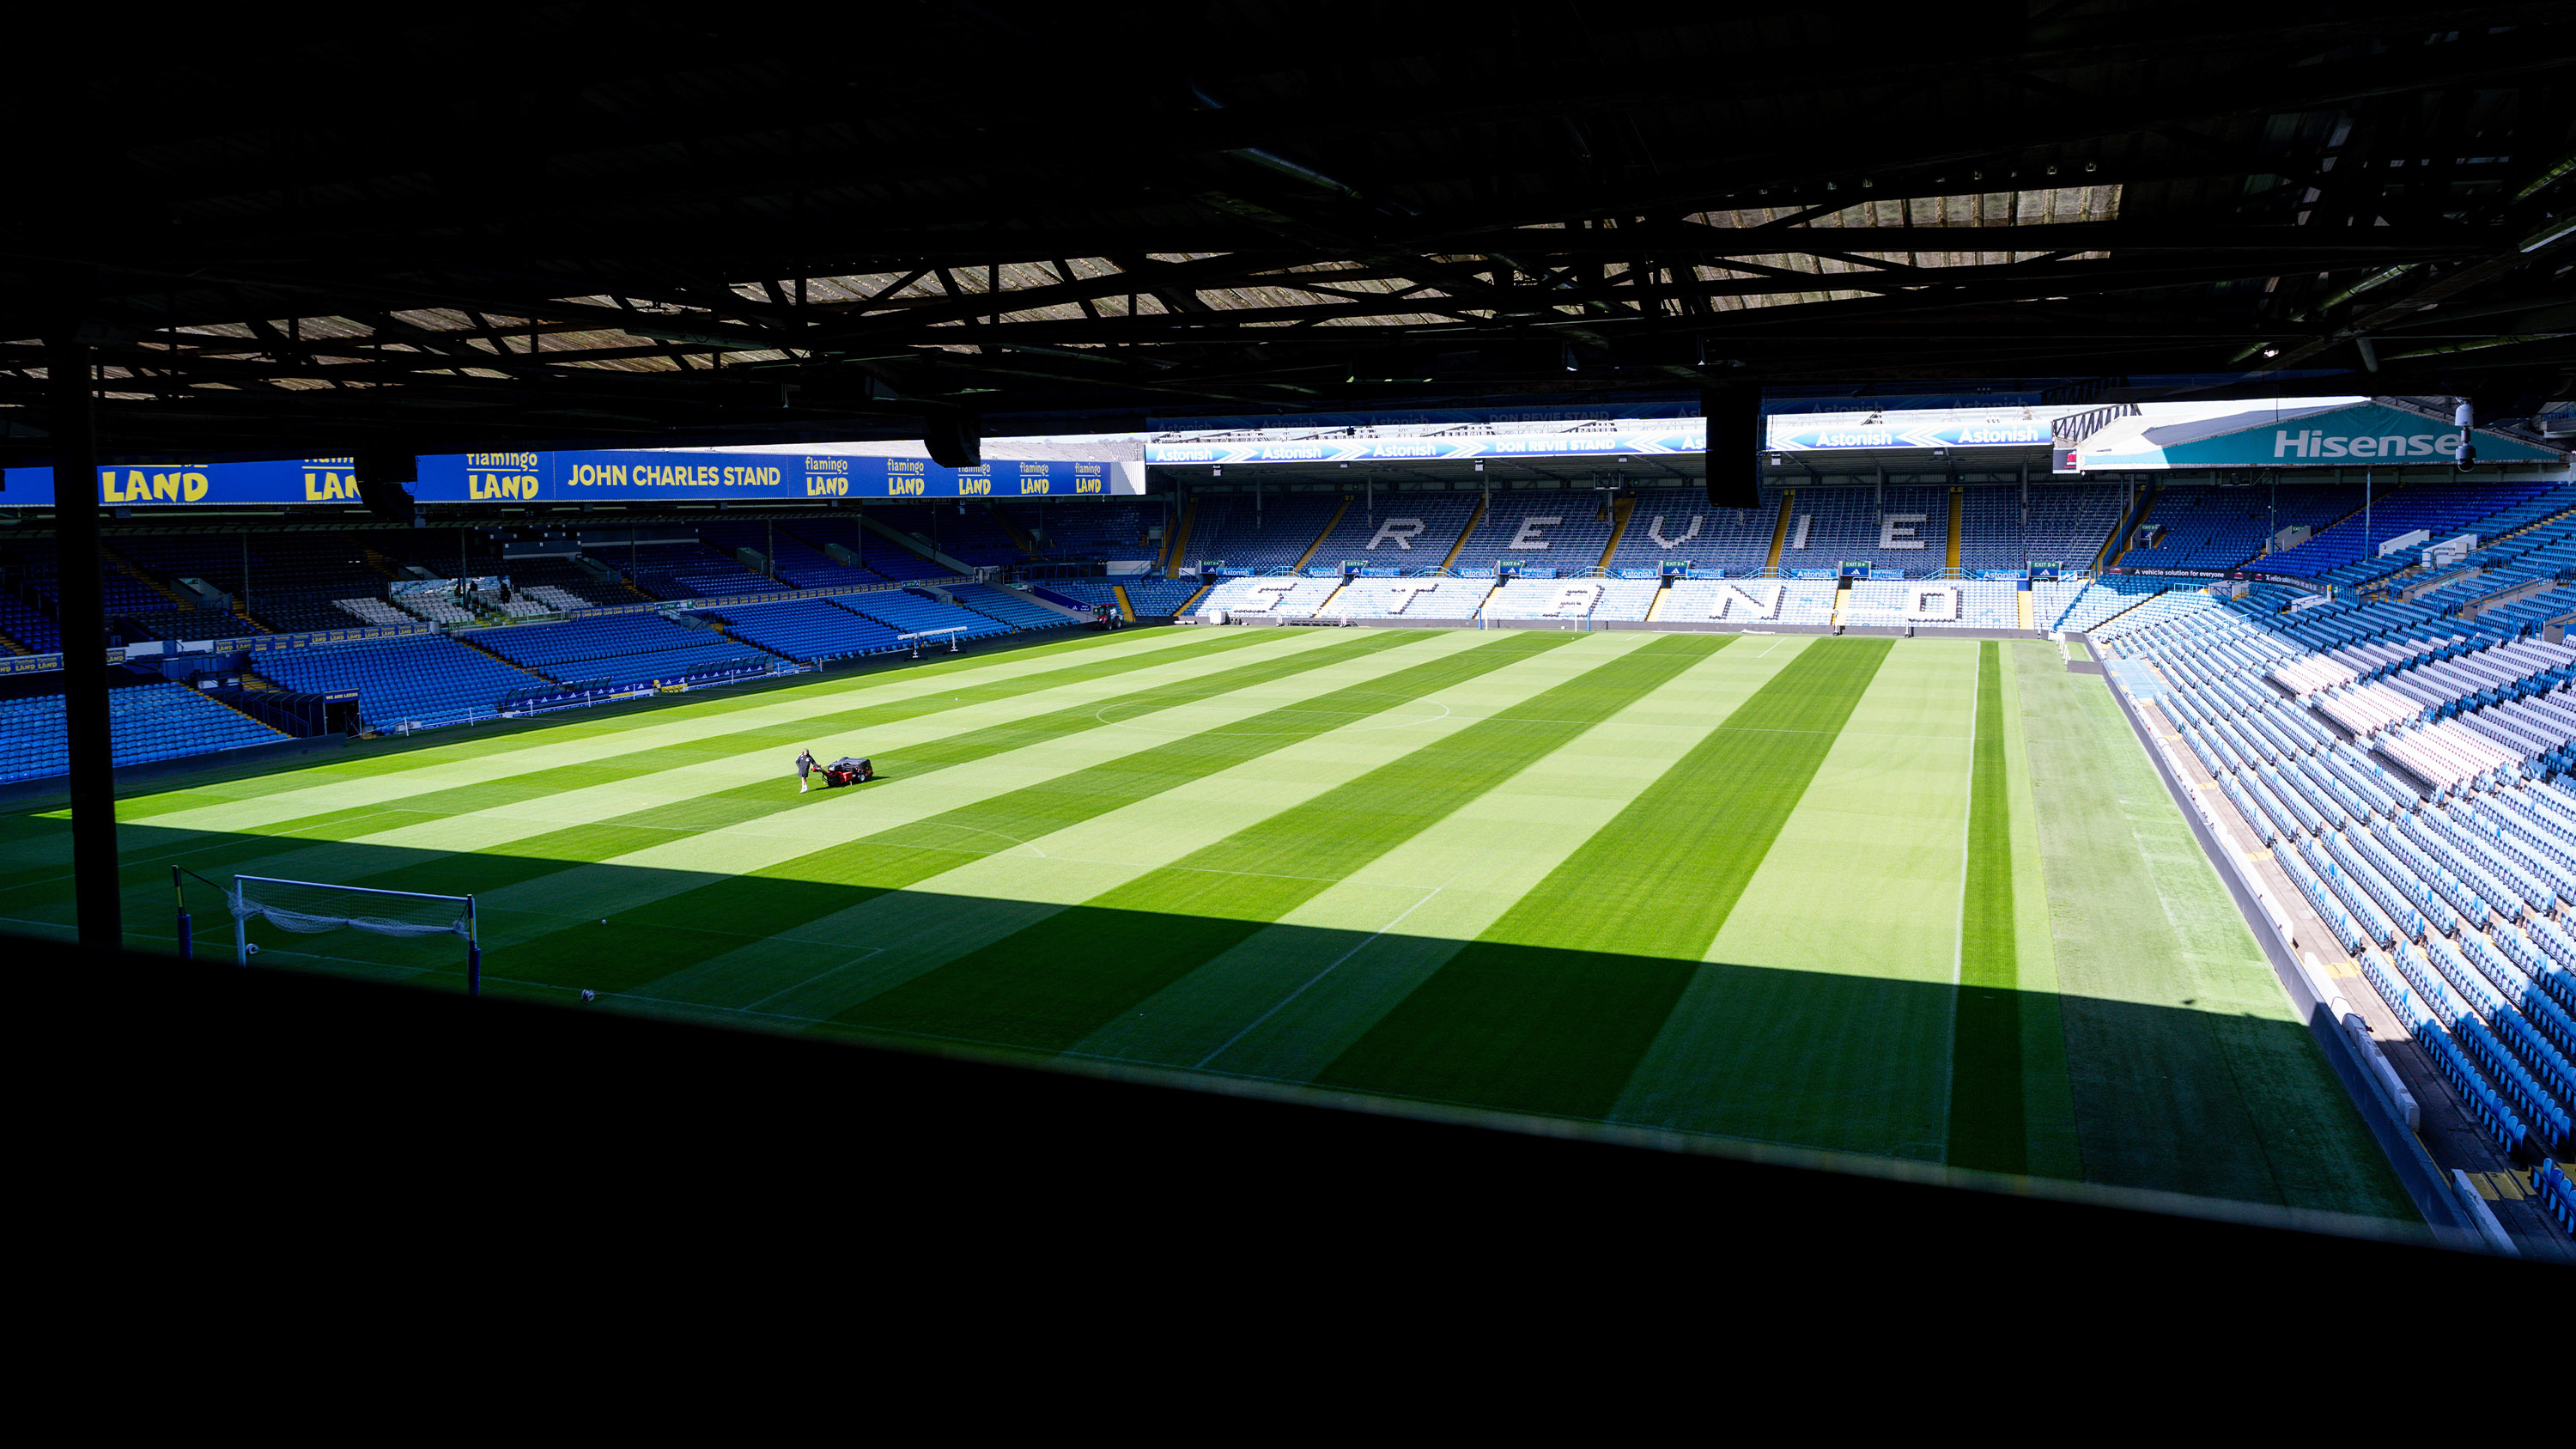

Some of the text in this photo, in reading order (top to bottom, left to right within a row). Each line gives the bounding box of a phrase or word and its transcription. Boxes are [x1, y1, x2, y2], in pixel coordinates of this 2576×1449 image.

[1522, 412, 1560, 422] REVIE
[1565, 411, 1609, 421] STAND
[1816, 430, 1892, 447] Astonish
[1958, 427, 2038, 443] Astonish
[2274, 430, 2462, 457] Hisense
[1156, 447, 1212, 461] Astonish
[1261, 446, 1321, 460] Astonish
[1374, 443, 1436, 457] Astonish
[1496, 440, 1615, 452] DON REVIE STAND
[805, 456, 848, 474] flamingo
[888, 459, 924, 476] flamingo
[1020, 461, 1049, 477] flamingo
[1075, 462, 1102, 477] flamingo
[568, 465, 781, 486] JOHN CHARLES STAND
[102, 470, 208, 502] LAND
[305, 472, 361, 501] LAN
[469, 473, 539, 500] LAND
[806, 477, 848, 496] LAND
[888, 477, 925, 496] LAND
[958, 478, 991, 496] LAND
[1020, 478, 1049, 495] LAND
[1076, 478, 1102, 494] LAND
[1984, 570, 2020, 579] Astonish
